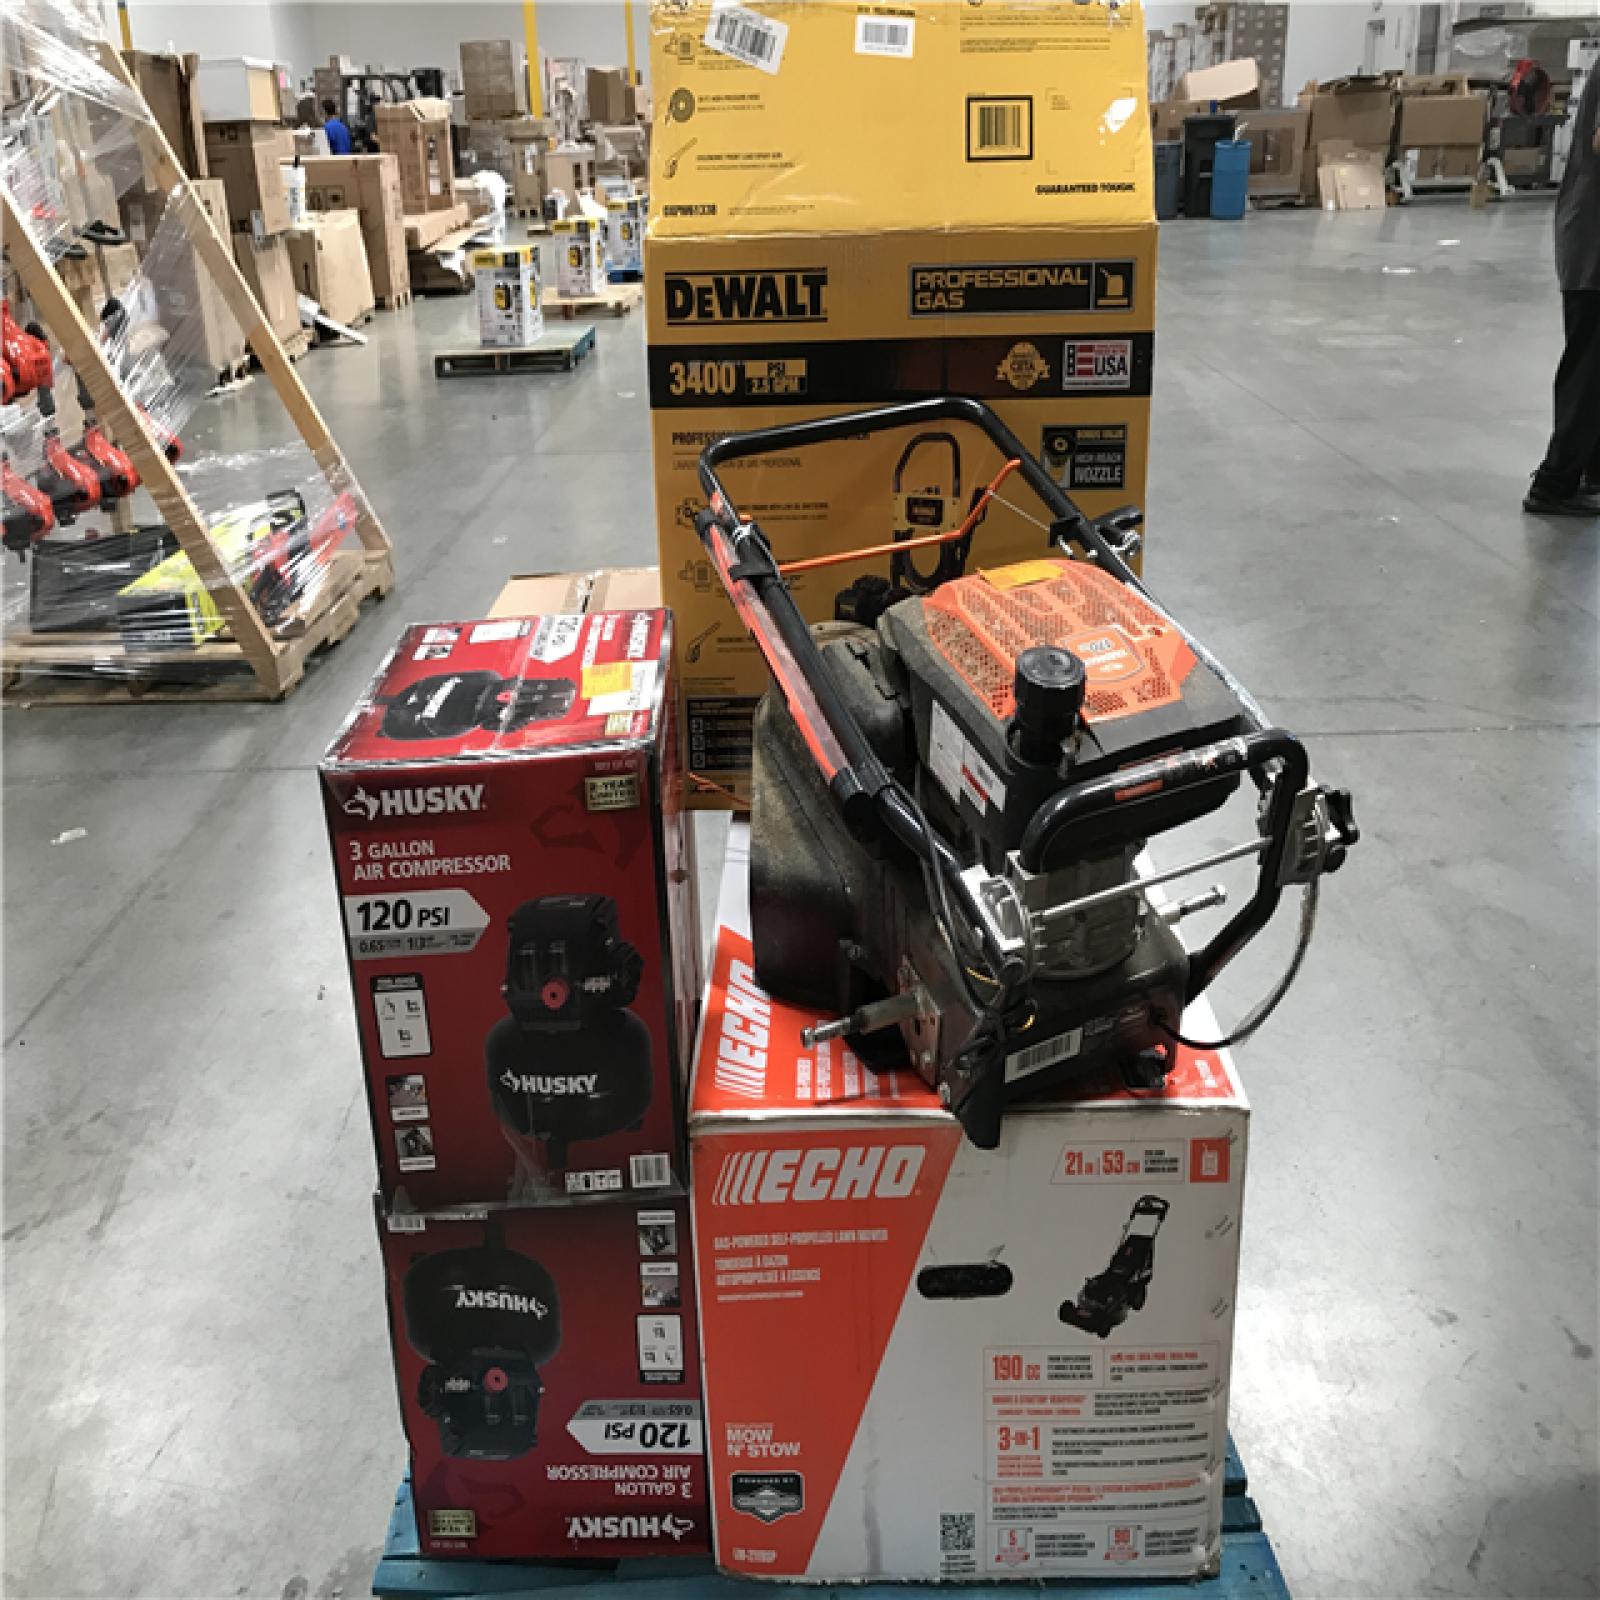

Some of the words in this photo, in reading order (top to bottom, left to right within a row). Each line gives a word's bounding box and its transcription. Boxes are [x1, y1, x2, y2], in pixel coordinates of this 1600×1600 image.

[916, 267, 1088, 289] PROFESSIONAL
[916, 291, 964, 310] GAS
[1095, 355, 1128, 376] USA
[669, 361, 736, 396] 3400
[1075, 465, 1121, 483] NOZZLE
[380, 784, 484, 816] HUSKY
[350, 840, 362, 860] 3
[368, 840, 435, 859] GALLON
[354, 863, 385, 881] AIR
[389, 854, 511, 880] COMPRESSOR
[356, 899, 412, 932] 120
[417, 906, 450, 928] PSI
[520, 1074, 598, 1095] HUSKY
[1064, 1151, 1083, 1175] 21
[1102, 1150, 1125, 1175] 53
[757, 1144, 926, 1204] ECHO
[455, 1289, 529, 1313] HUSKY
[992, 1354, 1023, 1381] 190
[604, 1421, 636, 1440] PSI
[638, 1421, 691, 1449] 120
[726, 1429, 773, 1443] MOW
[547, 1464, 658, 1481] COMPRESSOR
[662, 1464, 691, 1480] AIR
[614, 1482, 675, 1497] GALLON
[681, 1482, 693, 1498] 3
[567, 1516, 661, 1538] HUSKY
